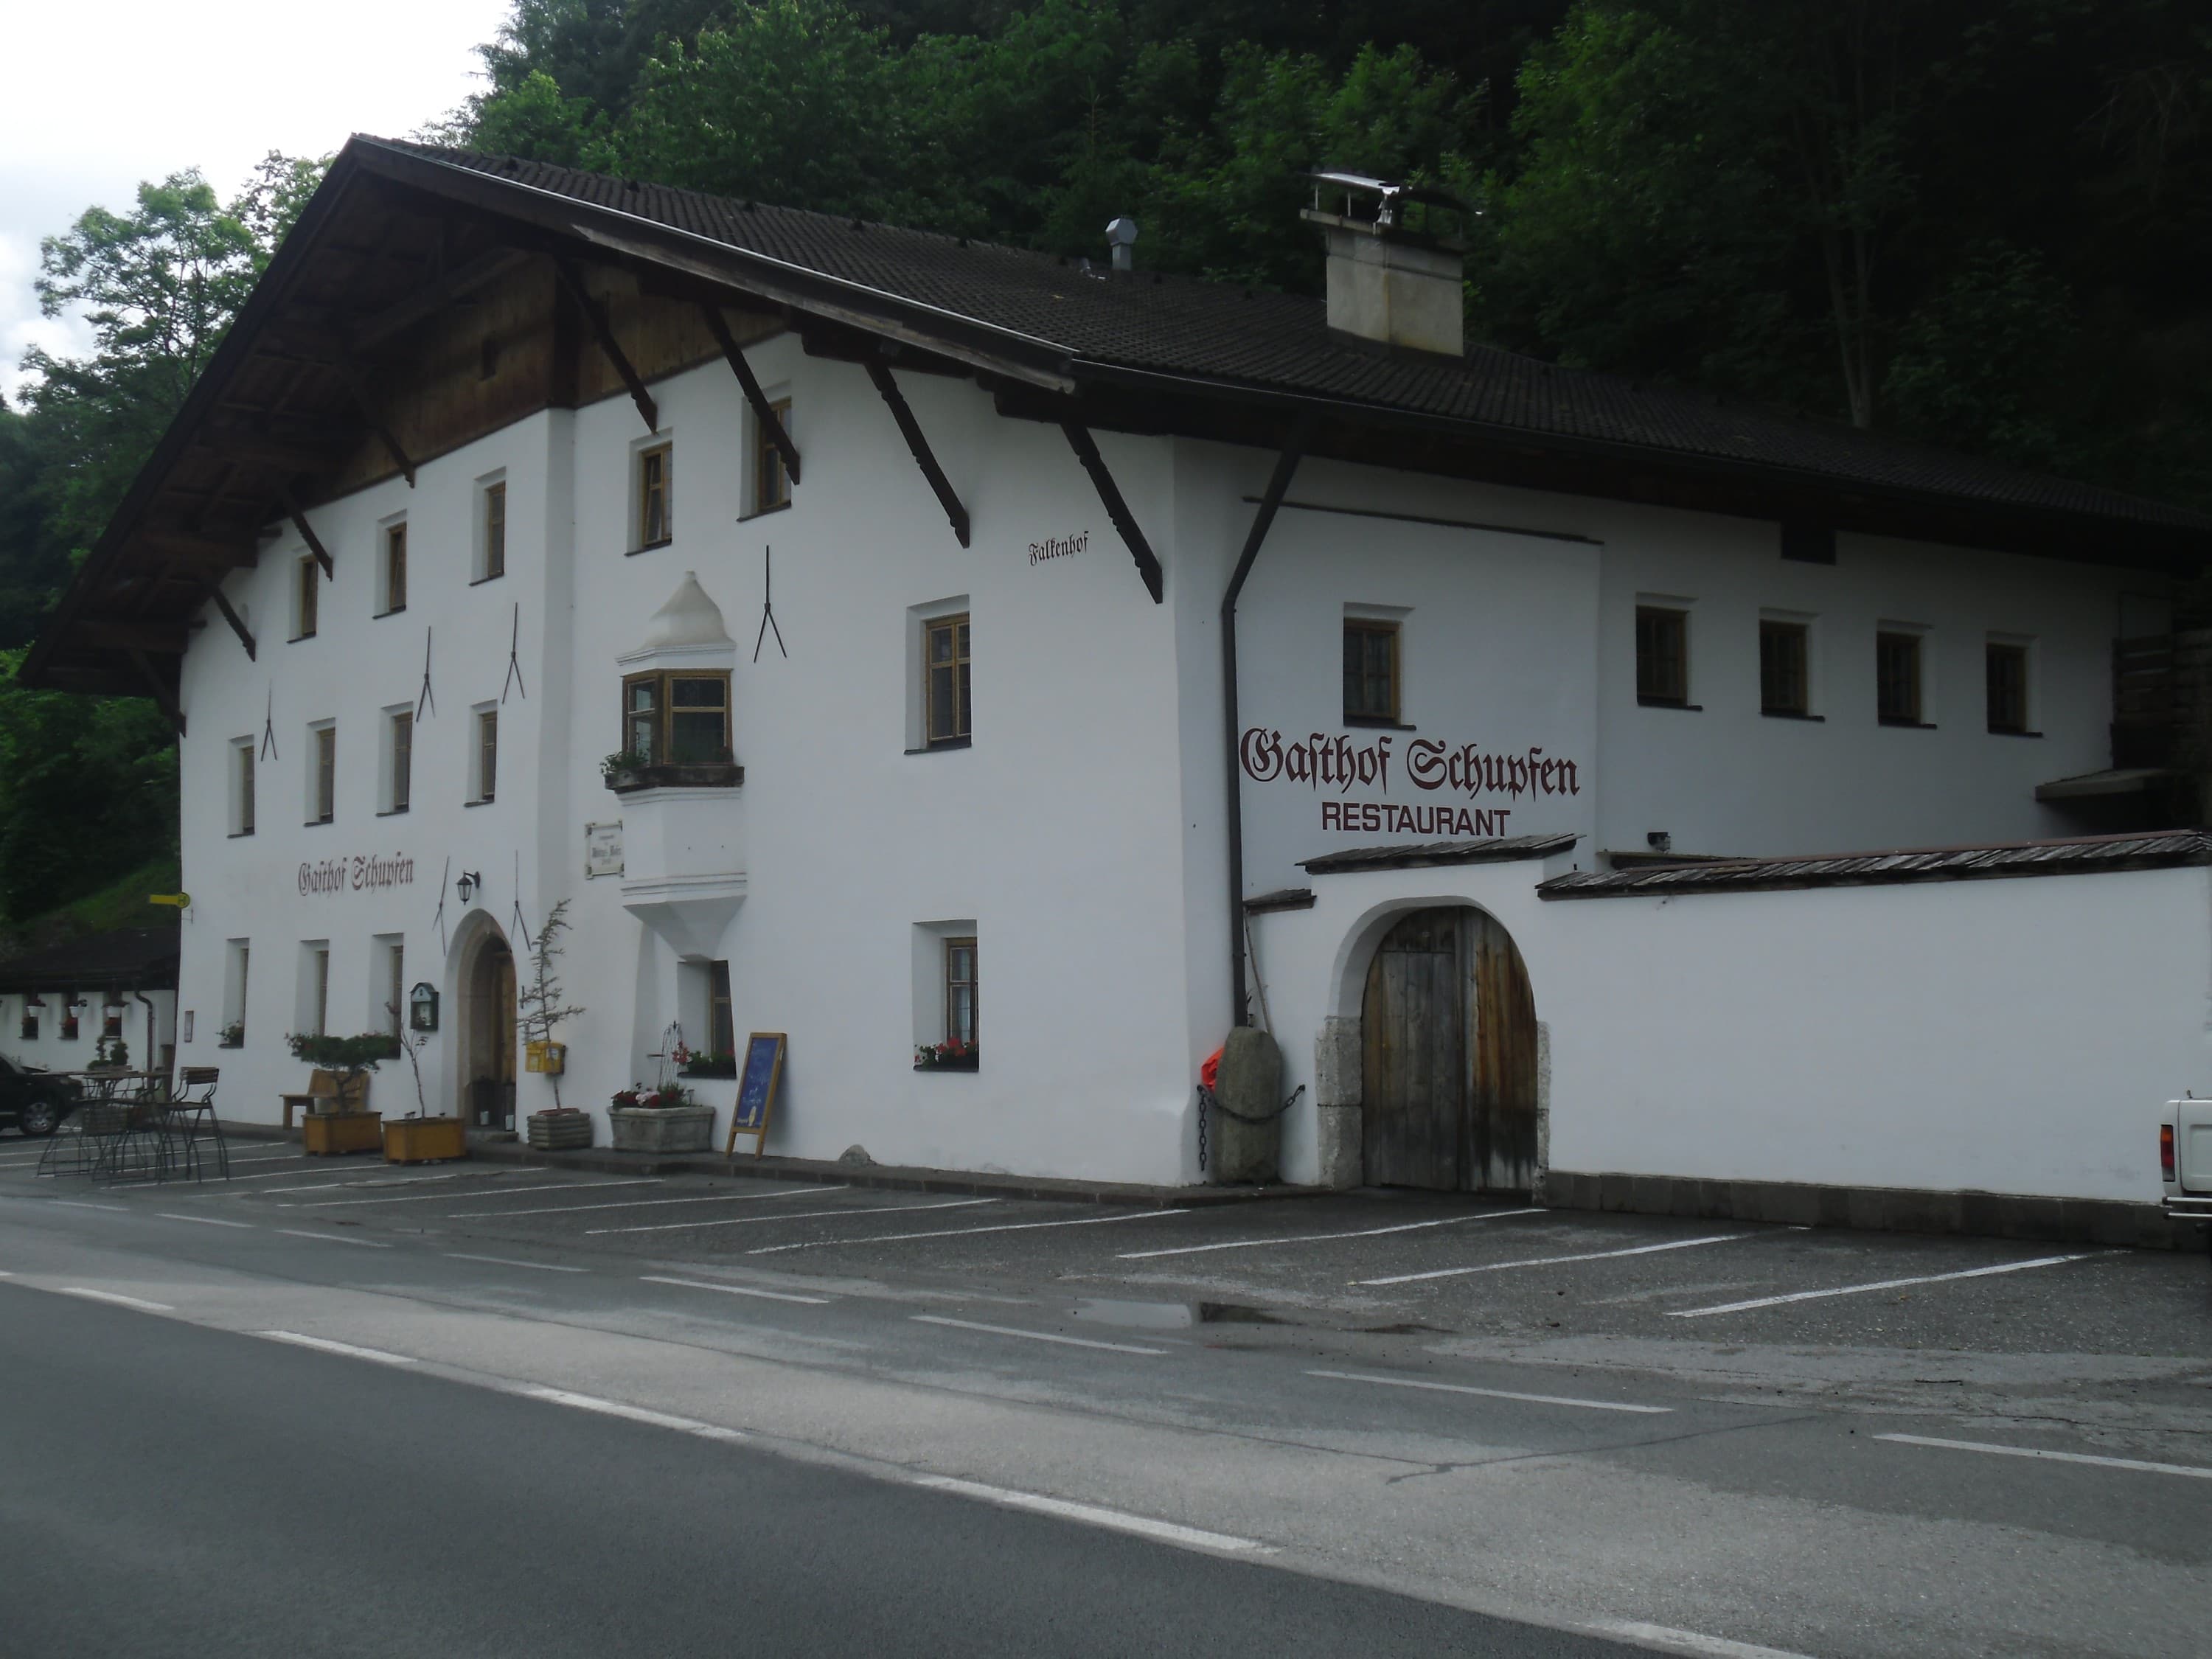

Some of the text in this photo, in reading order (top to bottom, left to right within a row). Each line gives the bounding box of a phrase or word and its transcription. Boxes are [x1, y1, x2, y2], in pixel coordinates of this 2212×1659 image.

[1029, 530, 1088, 566] Falkenhof
[1240, 728, 1580, 802] Gasthof Schupfen
[1322, 802, 1510, 837] RESTAURANT
[352, 851, 414, 894] Schupfen
